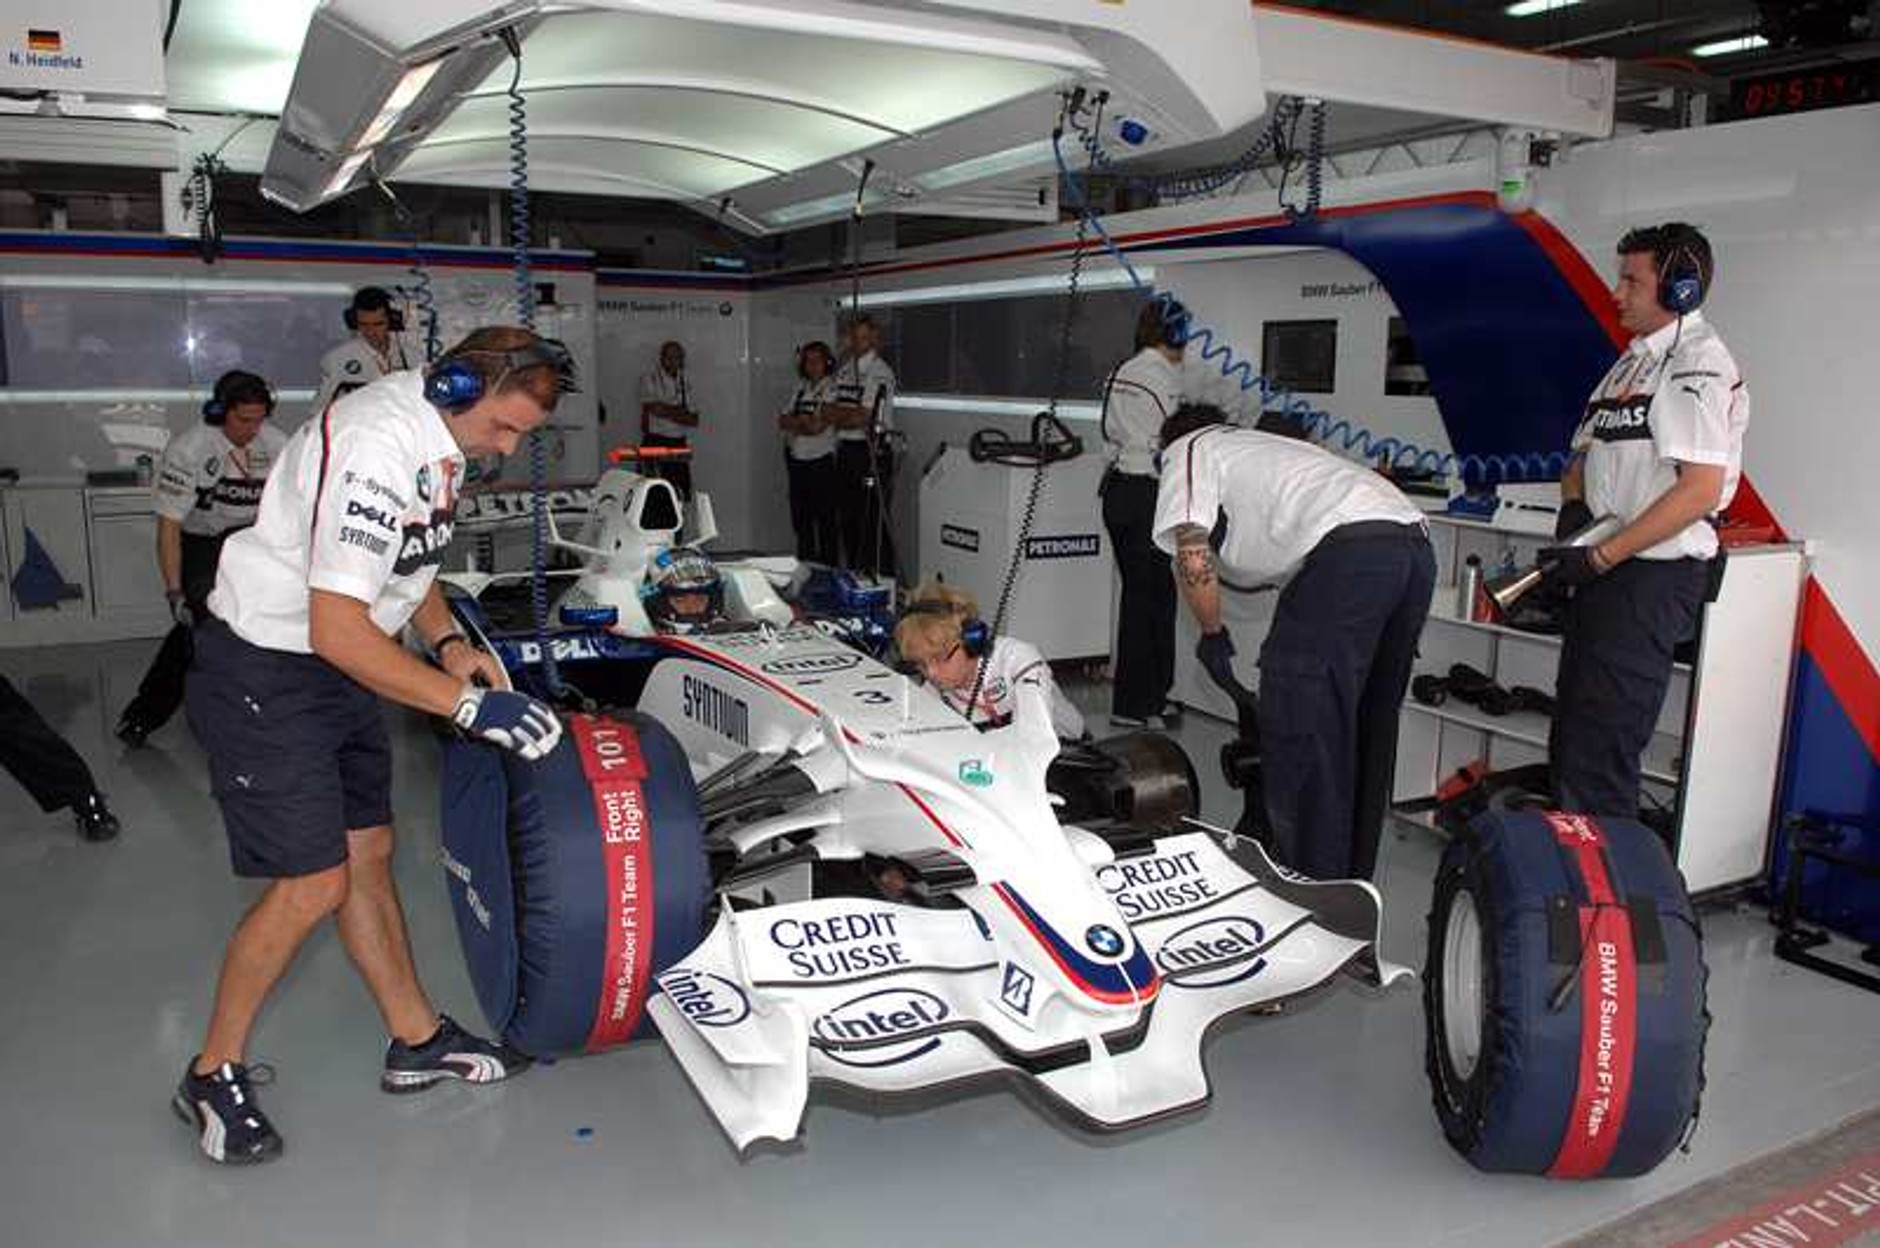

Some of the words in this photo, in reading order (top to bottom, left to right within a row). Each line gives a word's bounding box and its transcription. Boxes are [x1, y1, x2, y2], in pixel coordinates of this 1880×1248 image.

[26, 52, 82, 69] Heidfeld
[346, 500, 397, 532] DELL
[1029, 536, 1097, 557] PETRONAS
[683, 673, 749, 748] SYNTIUM
[853, 690, 893, 704] 3
[592, 729, 627, 770] 101
[603, 791, 623, 844] Front
[621, 789, 644, 841] Right
[621, 855, 638, 903] Team
[1096, 851, 1202, 894] CREDIT
[621, 907, 638, 927] F1
[1116, 879, 1219, 918] SUISSE
[770, 913, 896, 950] CREDIT
[1160, 927, 1256, 966] intel
[788, 943, 911, 978] SUISSE
[1598, 942, 1618, 997] BMW
[663, 971, 733, 1020] intel
[822, 1000, 934, 1038] intel
[1598, 999, 1618, 1066] Sauber
[1597, 1072, 1613, 1093] F1
[1588, 1096, 1610, 1137] Team
